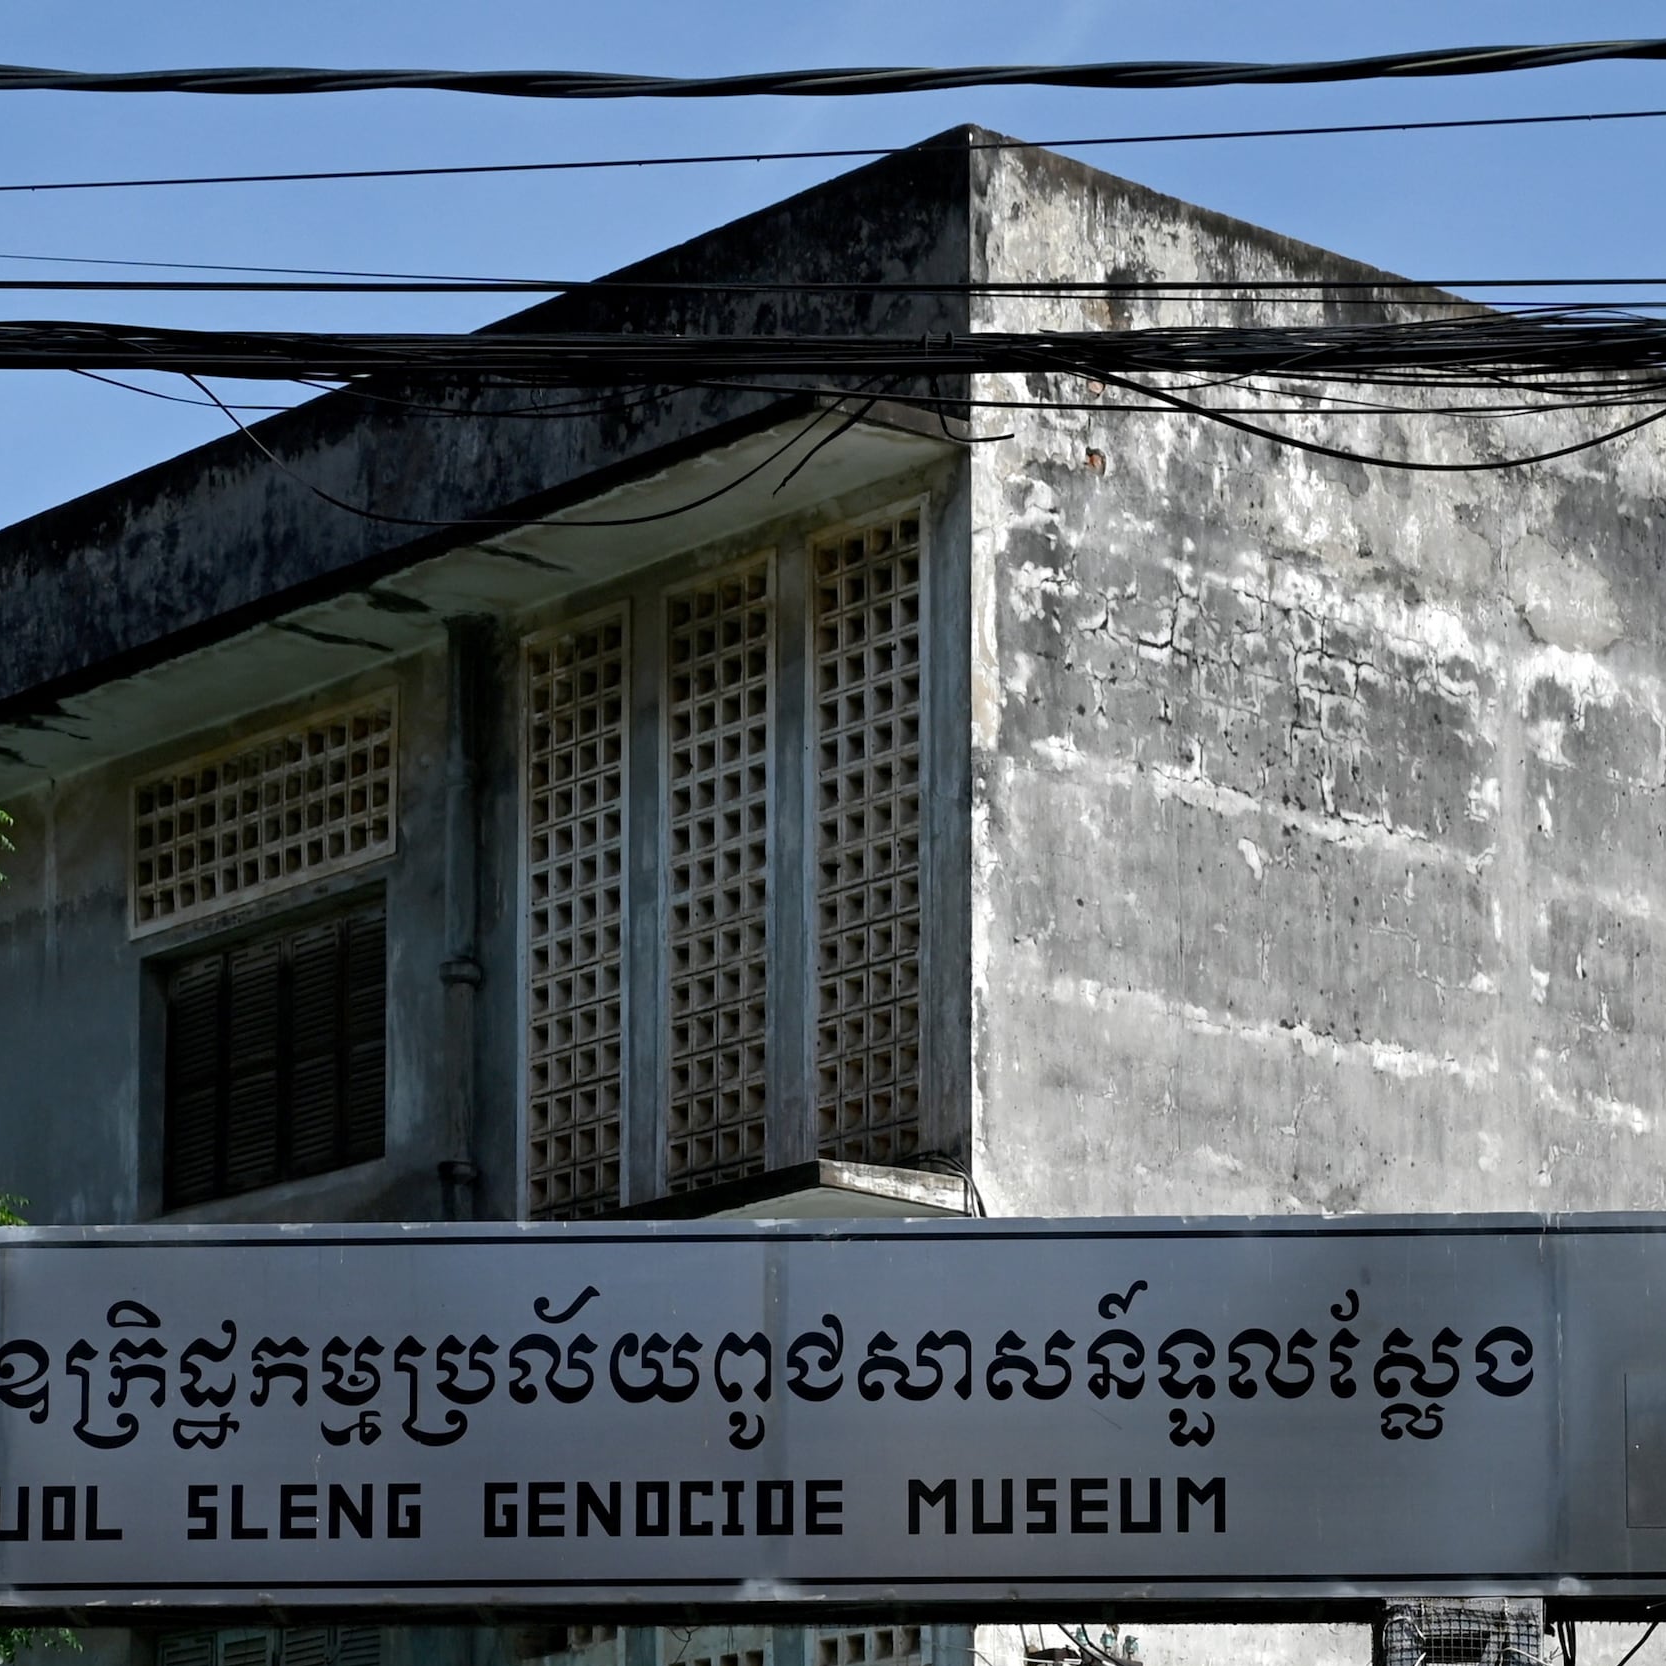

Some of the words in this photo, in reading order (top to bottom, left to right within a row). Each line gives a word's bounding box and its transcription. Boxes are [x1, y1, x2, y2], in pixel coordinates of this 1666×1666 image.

[186, 1482, 423, 1541] SLENG
[482, 1479, 844, 1539] GENOCIDE
[907, 1477, 1227, 1536] MUSEUM
